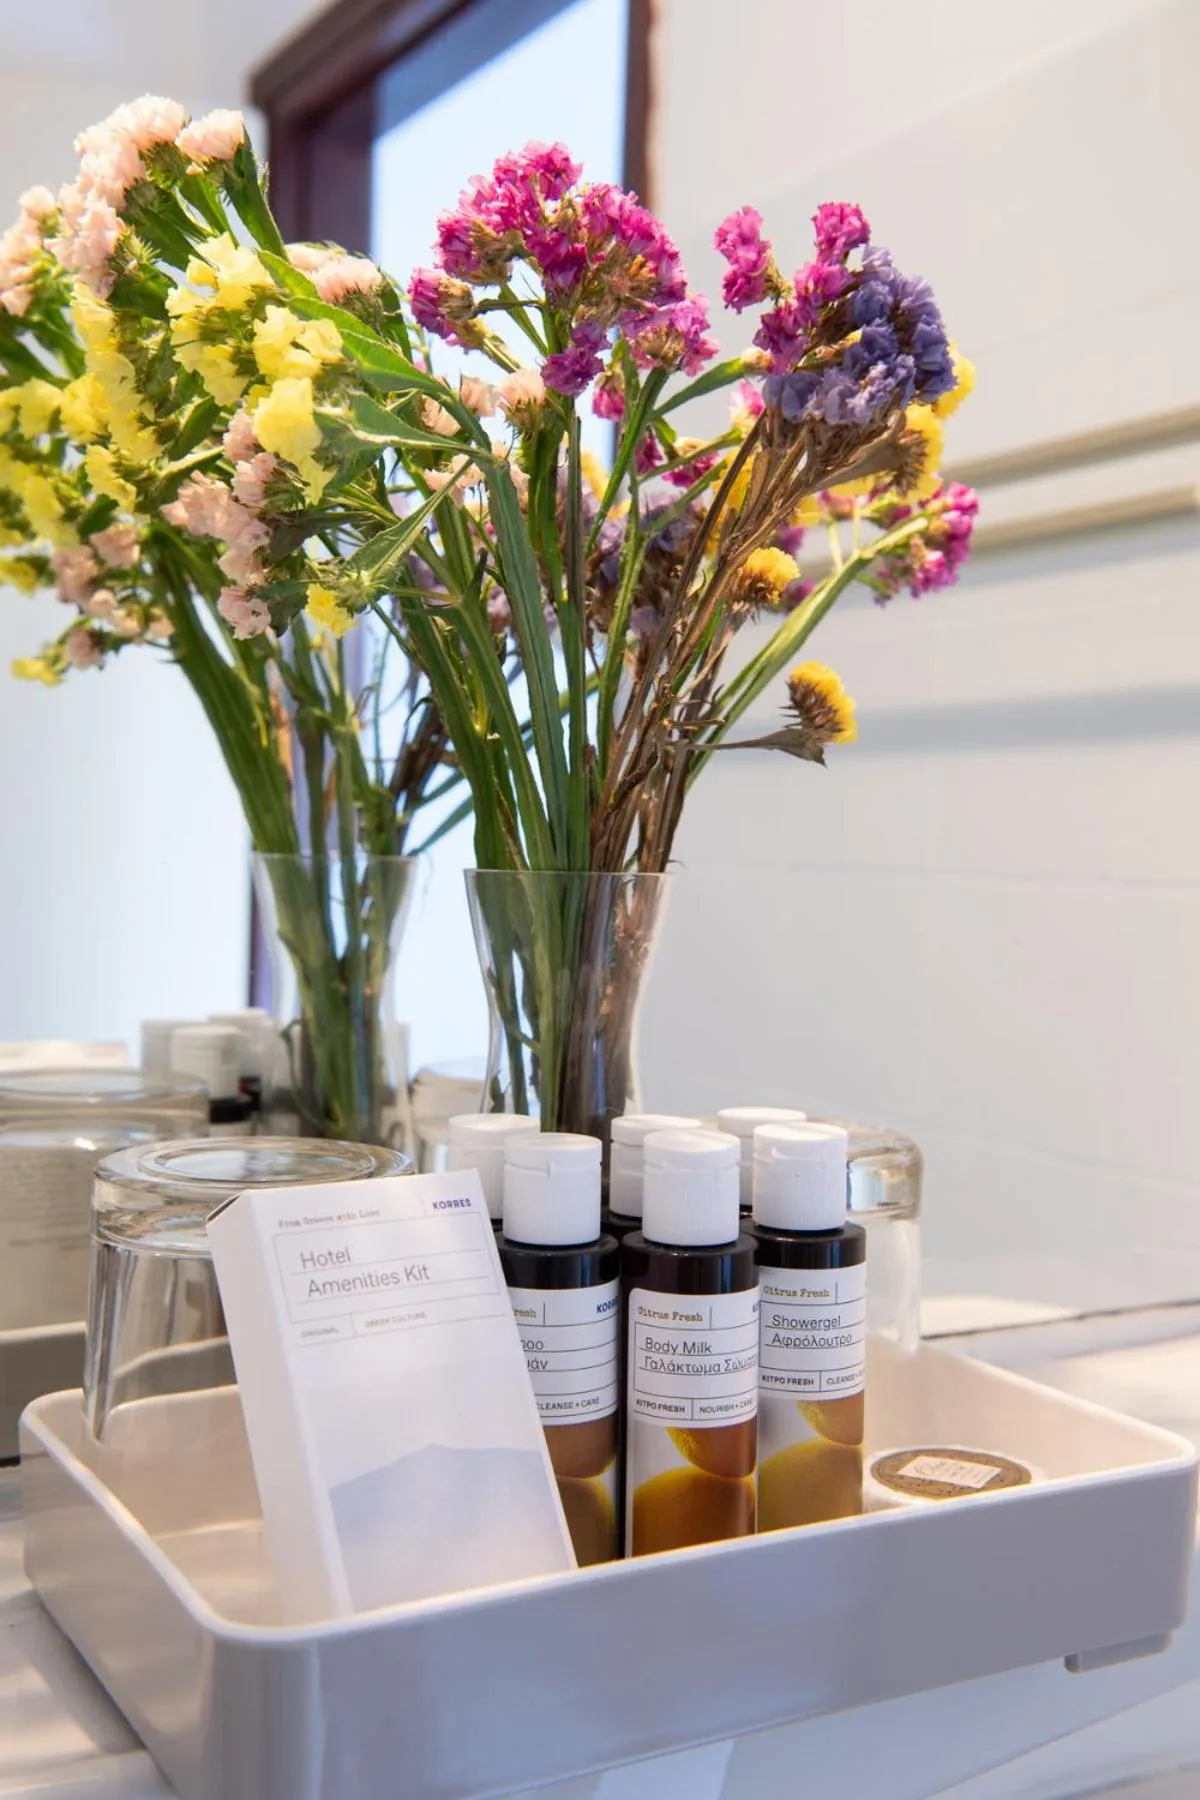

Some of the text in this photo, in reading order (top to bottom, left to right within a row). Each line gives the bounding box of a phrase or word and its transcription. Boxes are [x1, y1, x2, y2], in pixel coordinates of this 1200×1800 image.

[432, 1197, 472, 1210] KORRES
[278, 1220, 301, 1229] From
[337, 1211, 357, 1221] with
[359, 1209, 380, 1219] Love
[300, 1247, 351, 1270] Hotel
[307, 1265, 431, 1298] Amenities Kit
[763, 1285, 830, 1298] Citrus Fresh
[513, 1308, 537, 1319] resh
[638, 1306, 703, 1322] Citrus Fresh
[772, 1314, 841, 1331] Showergel
[645, 1337, 713, 1355] Body Milk
[771, 1333, 852, 1349] Αφρόλουτρο
[645, 1356, 721, 1376] Γαλάκτωμα
[787, 1376, 814, 1386] FRESH
[581, 1397, 600, 1407] CARE
[658, 1402, 685, 1413] FRESH
[699, 1403, 734, 1414] NOURISH
